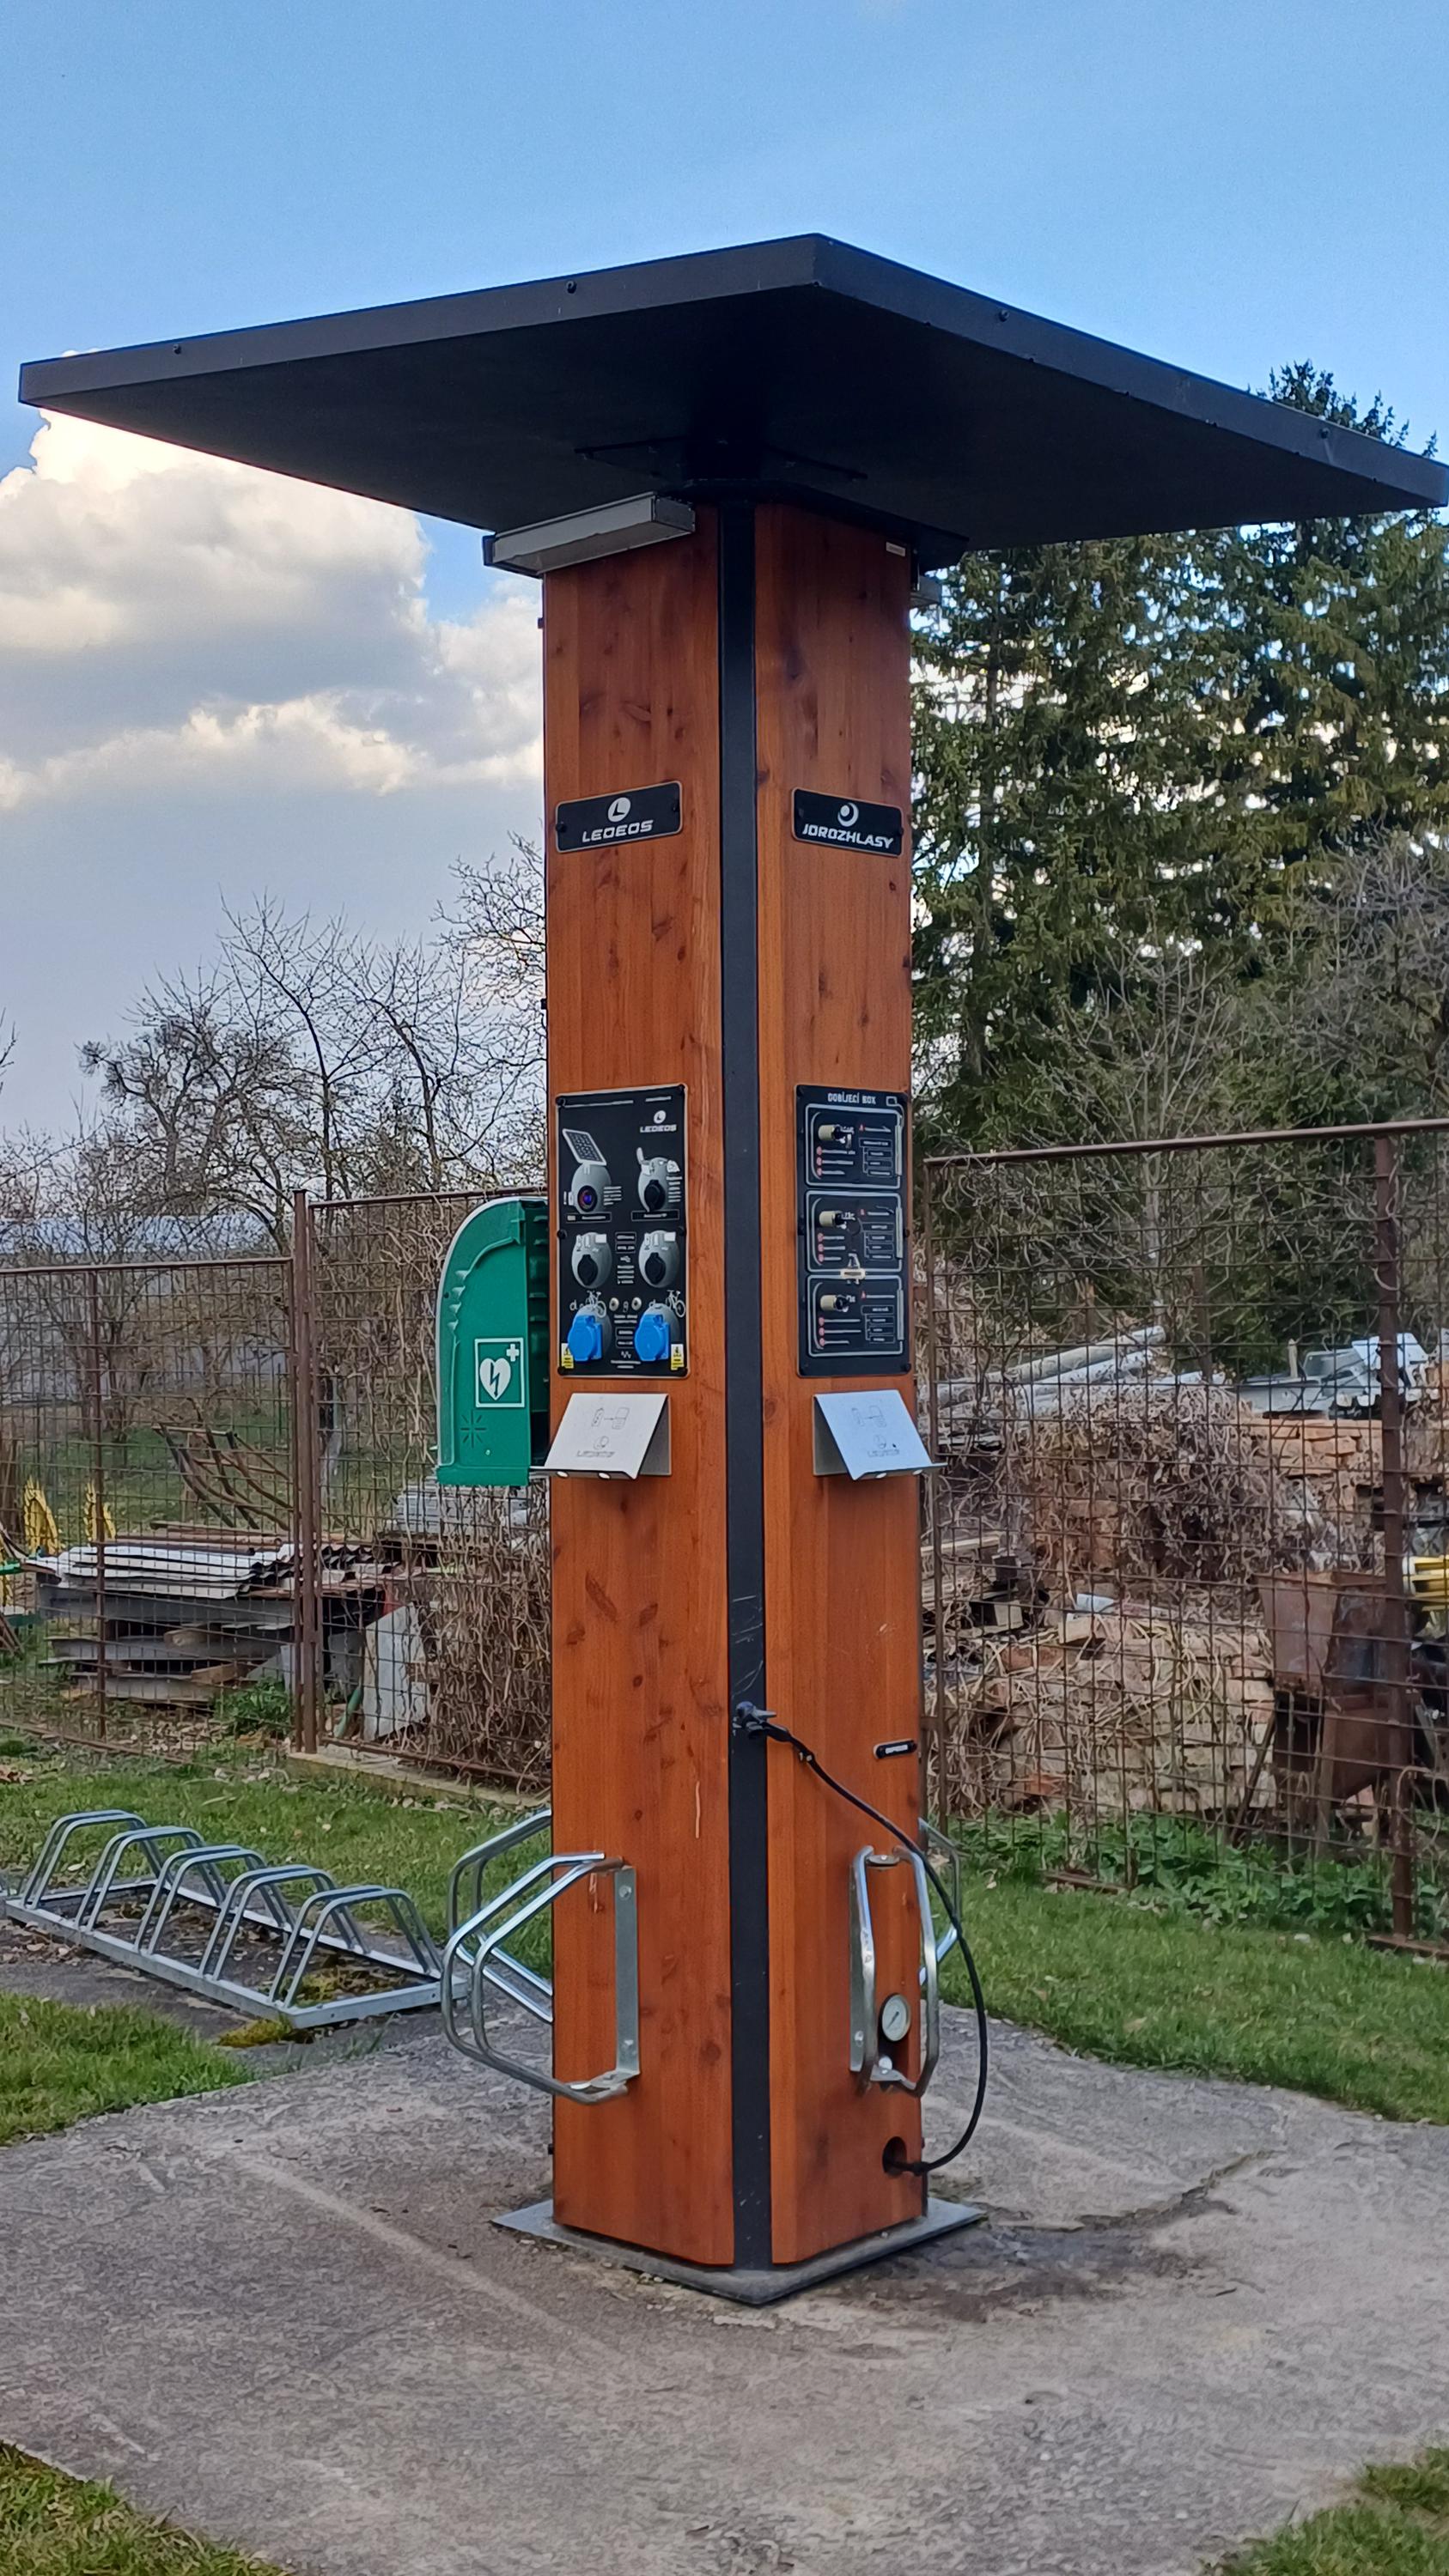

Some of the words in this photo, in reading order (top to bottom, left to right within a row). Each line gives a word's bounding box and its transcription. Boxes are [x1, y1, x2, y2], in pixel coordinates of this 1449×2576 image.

[581, 819, 654, 843] LEDEOS
[802, 823, 894, 849] JOROZHLASY
[861, 1095, 876, 1105] BOX
[639, 1124, 677, 1133] LEDEOS
